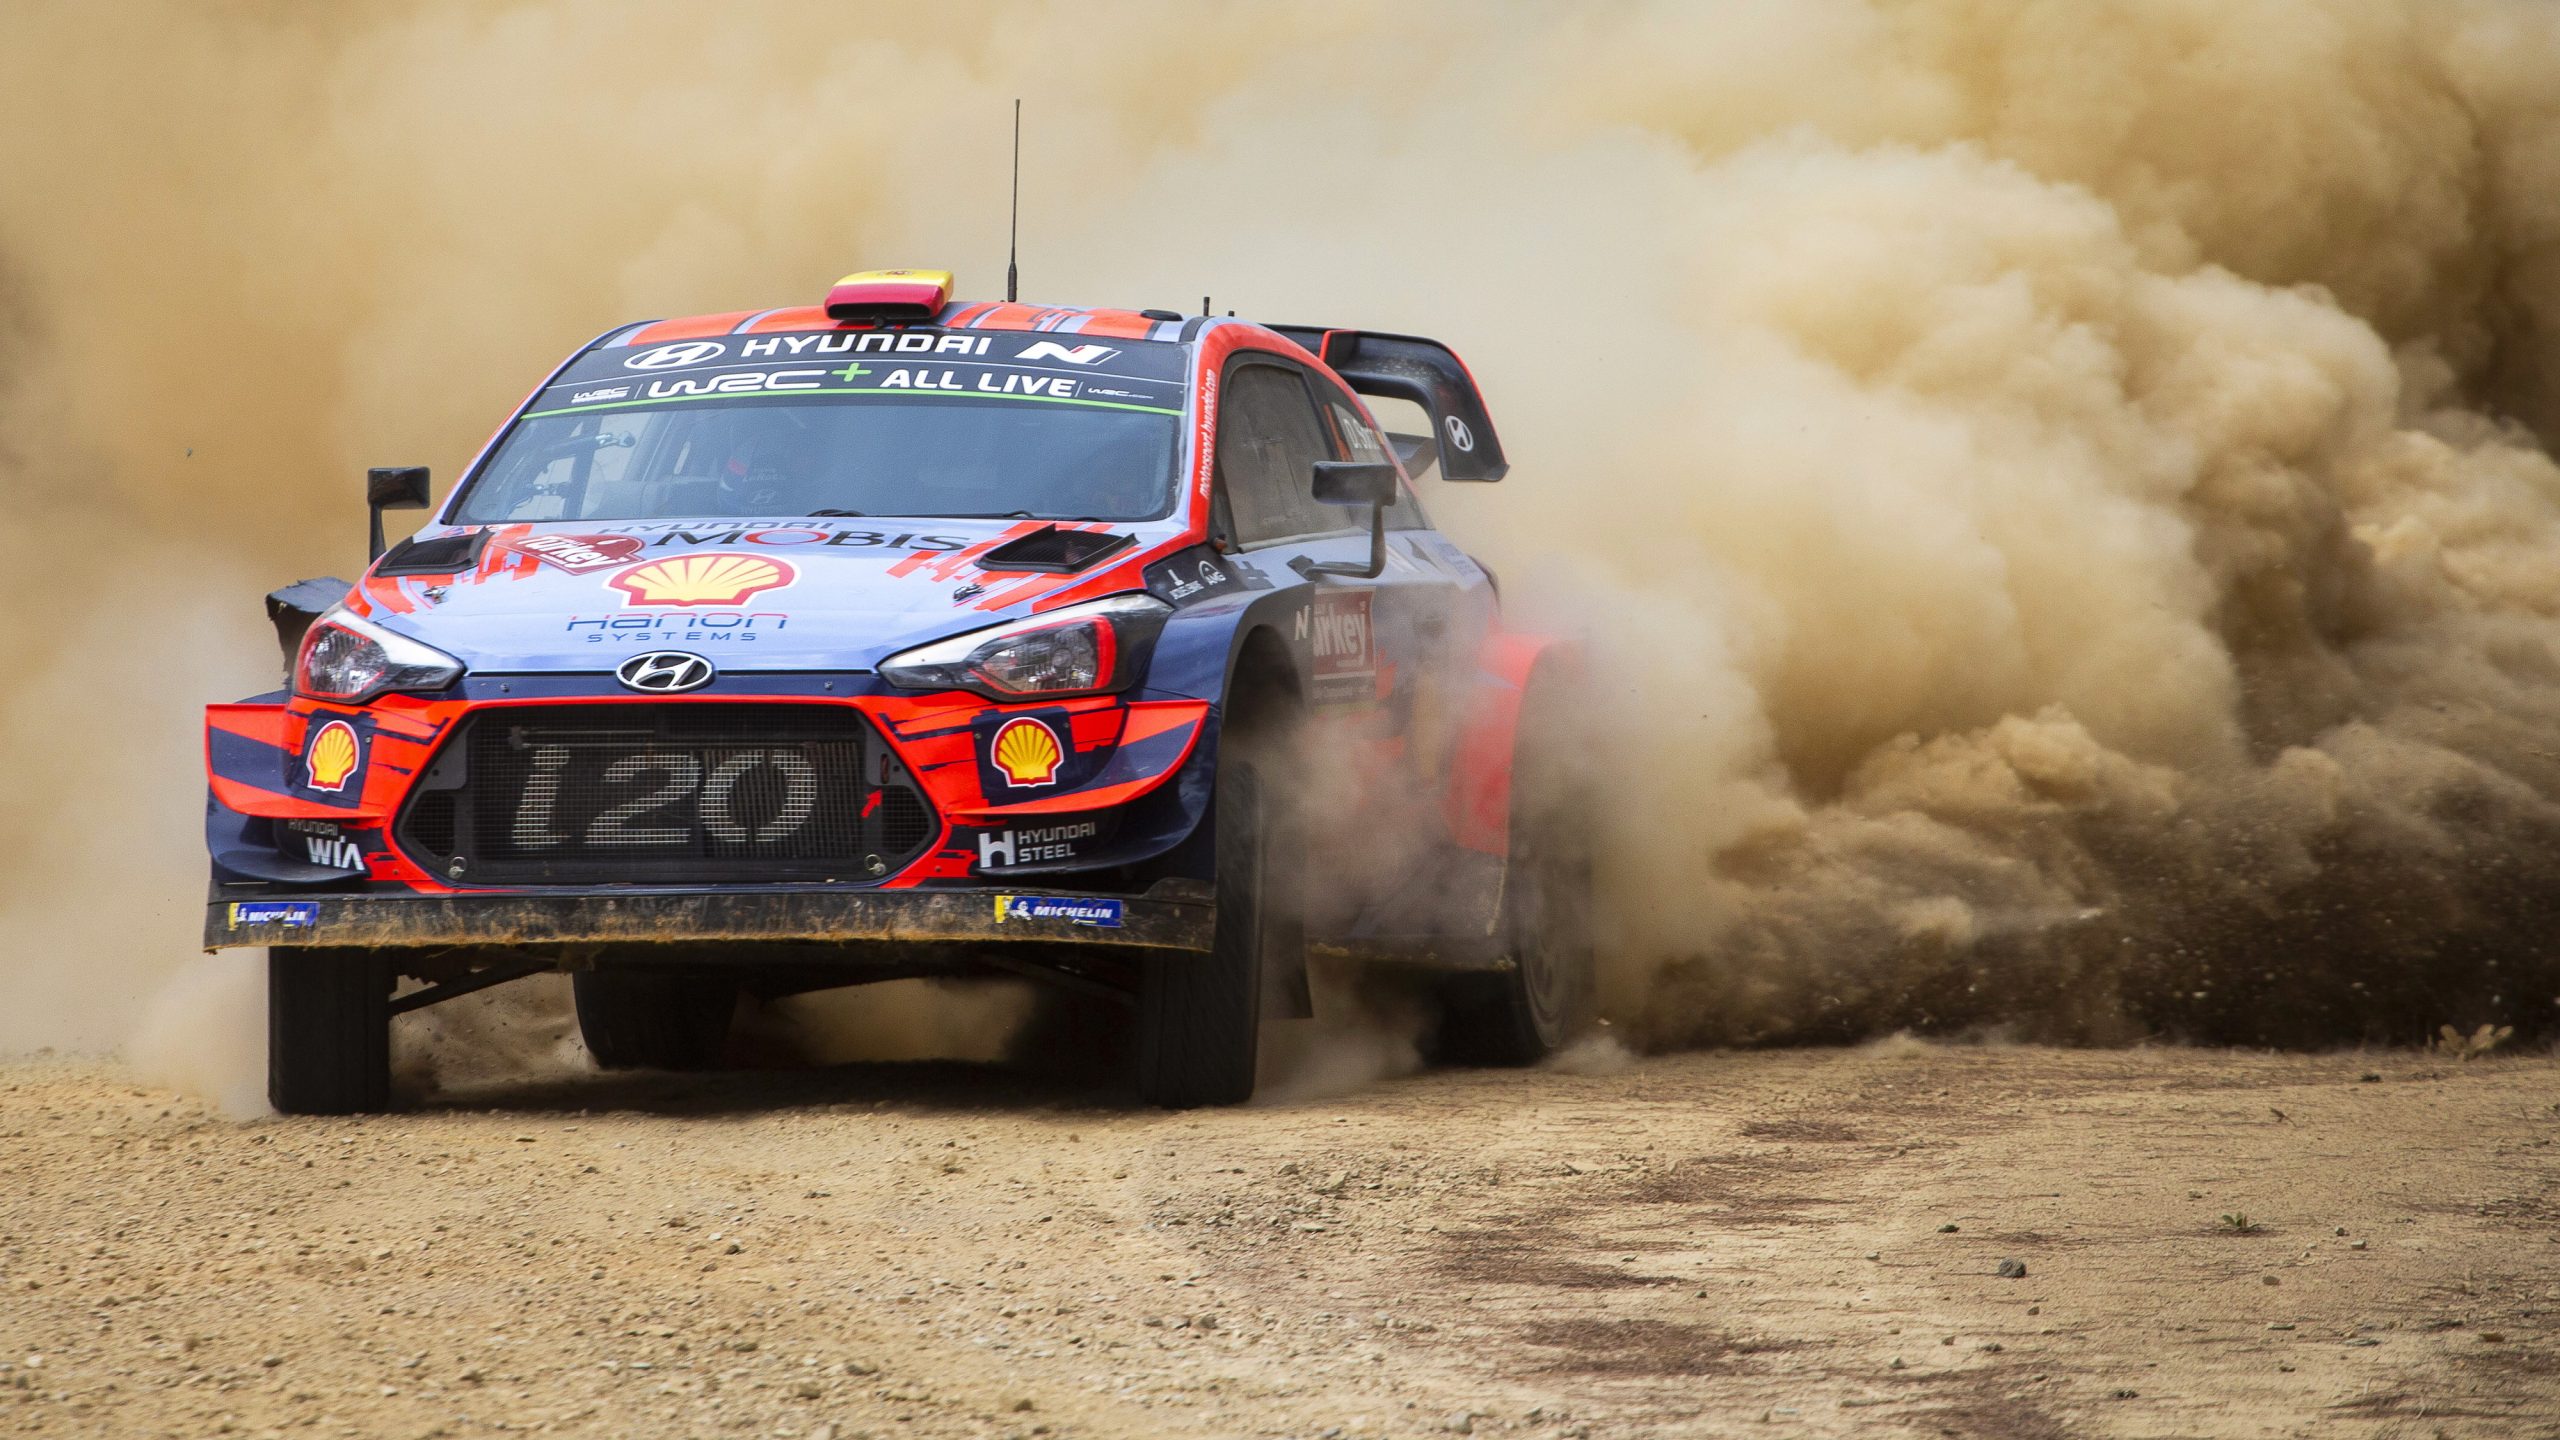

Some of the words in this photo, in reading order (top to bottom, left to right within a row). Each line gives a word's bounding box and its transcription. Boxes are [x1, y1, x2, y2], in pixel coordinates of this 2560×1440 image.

[740, 333, 992, 357] HYUNDAI
[880, 369, 964, 390] ALL
[977, 372, 1076, 397] LIVE
[598, 521, 834, 534] HYUNDAI
[651, 529, 971, 551] MOBIS
[587, 631, 758, 643] SYSTEMS
[1313, 602, 1365, 667] urkey
[1018, 822, 1096, 845] HYUNDAI
[1019, 844, 1076, 862] STEEL
[1033, 905, 1113, 919] MICHELIN
